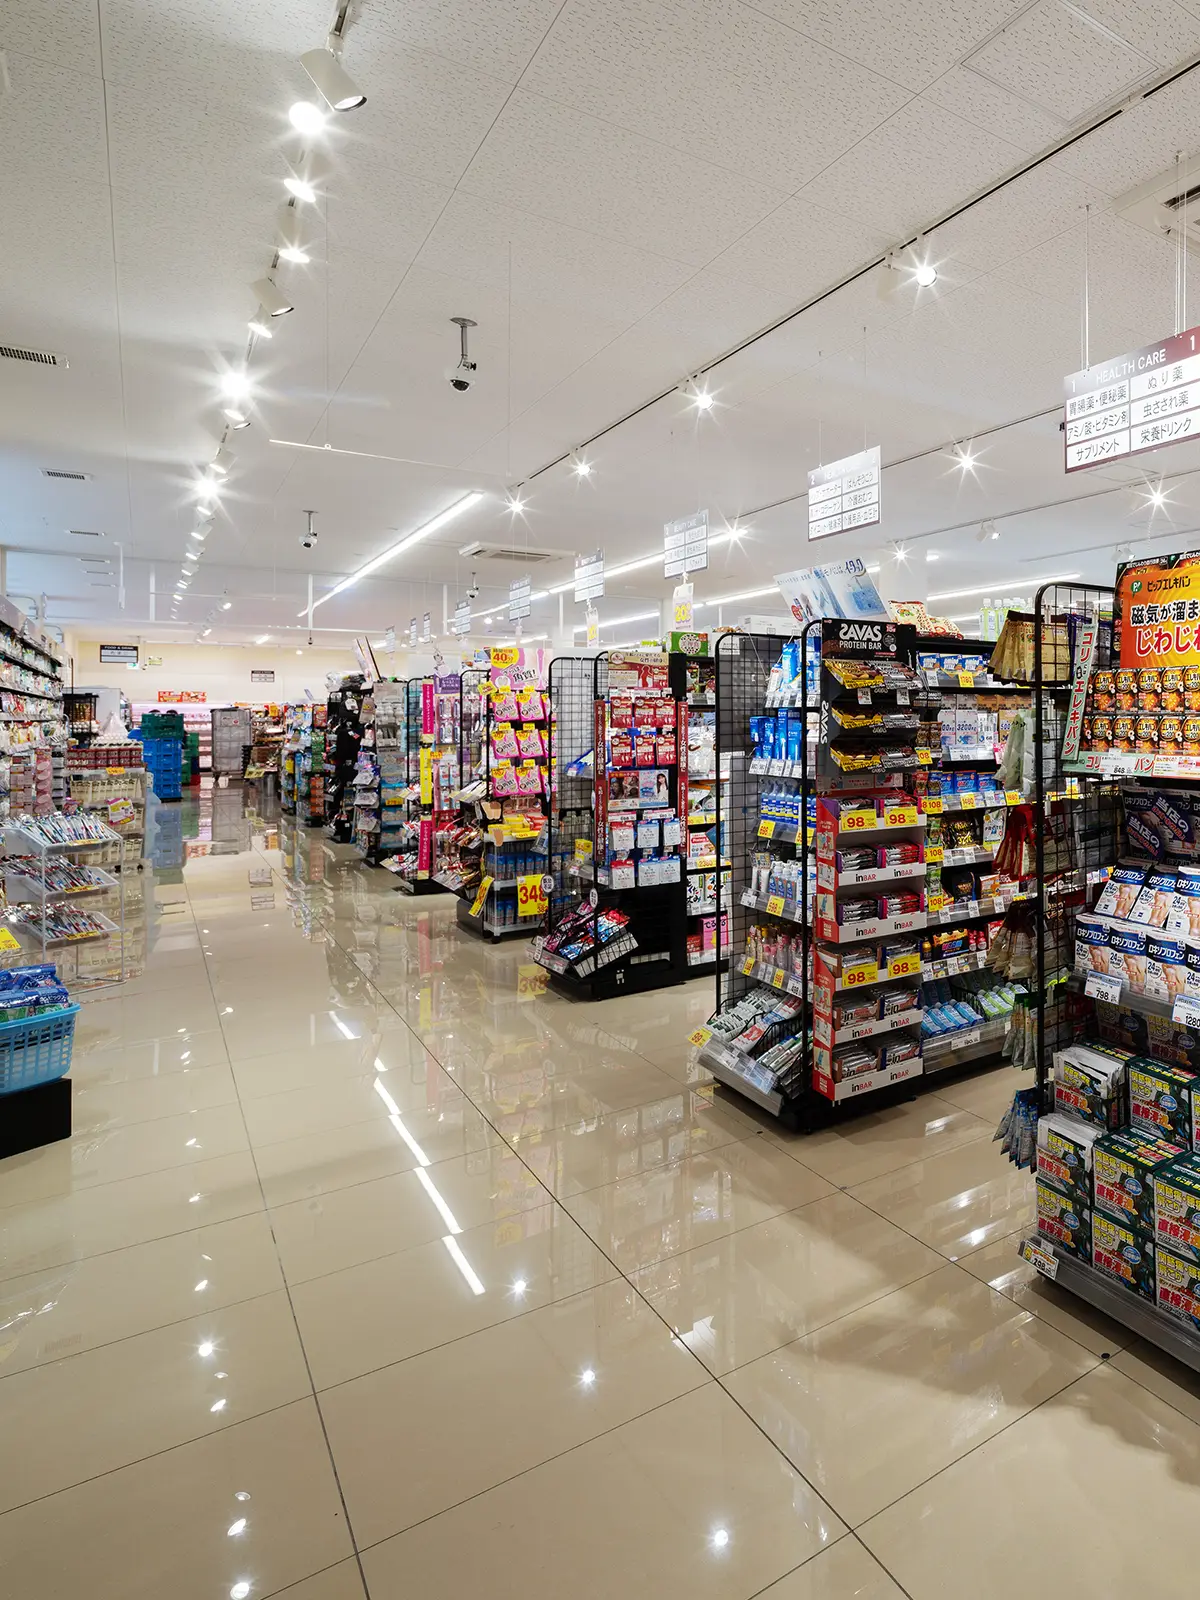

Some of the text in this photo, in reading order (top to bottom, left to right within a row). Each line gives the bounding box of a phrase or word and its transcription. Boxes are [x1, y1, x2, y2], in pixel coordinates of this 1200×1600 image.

[1190, 335, 1196, 351] 1
[1096, 348, 1167, 385] HEALTH CARE
[1143, 391, 1189, 418] 虫さされ薬
[1140, 417, 1192, 443] 栄養ドリンク
[1076, 438, 1120, 462] サプリメント
[1147, 575, 1191, 593] ピップエレキバン
[839, 641, 882, 650] PROTEIN BAR
[1064, 679, 1085, 755] エレキバン
[847, 816, 865, 828] 98
[889, 813, 906, 825] 98
[856, 874, 876, 882] inBAR
[894, 868, 913, 877] inBAR
[1113, 868, 1146, 881] ロキソプロフェン
[894, 921, 913, 930] inBAR
[856, 927, 876, 937] inBAR
[1077, 928, 1110, 942] ロキソプロフェン
[1110, 935, 1146, 951] ロキソプロフェン
[1148, 944, 1185, 961] ロキソプロフェン
[892, 961, 908, 974] 98
[847, 973, 865, 984] 98
[1096, 989, 1109, 1001] 798
[890, 1018, 909, 1028] inBAR
[1185, 1014, 1200, 1028] 1280
[852, 1027, 872, 1038] inBAR
[890, 1069, 909, 1080] inBAR
[851, 1081, 872, 1092] inBAR
